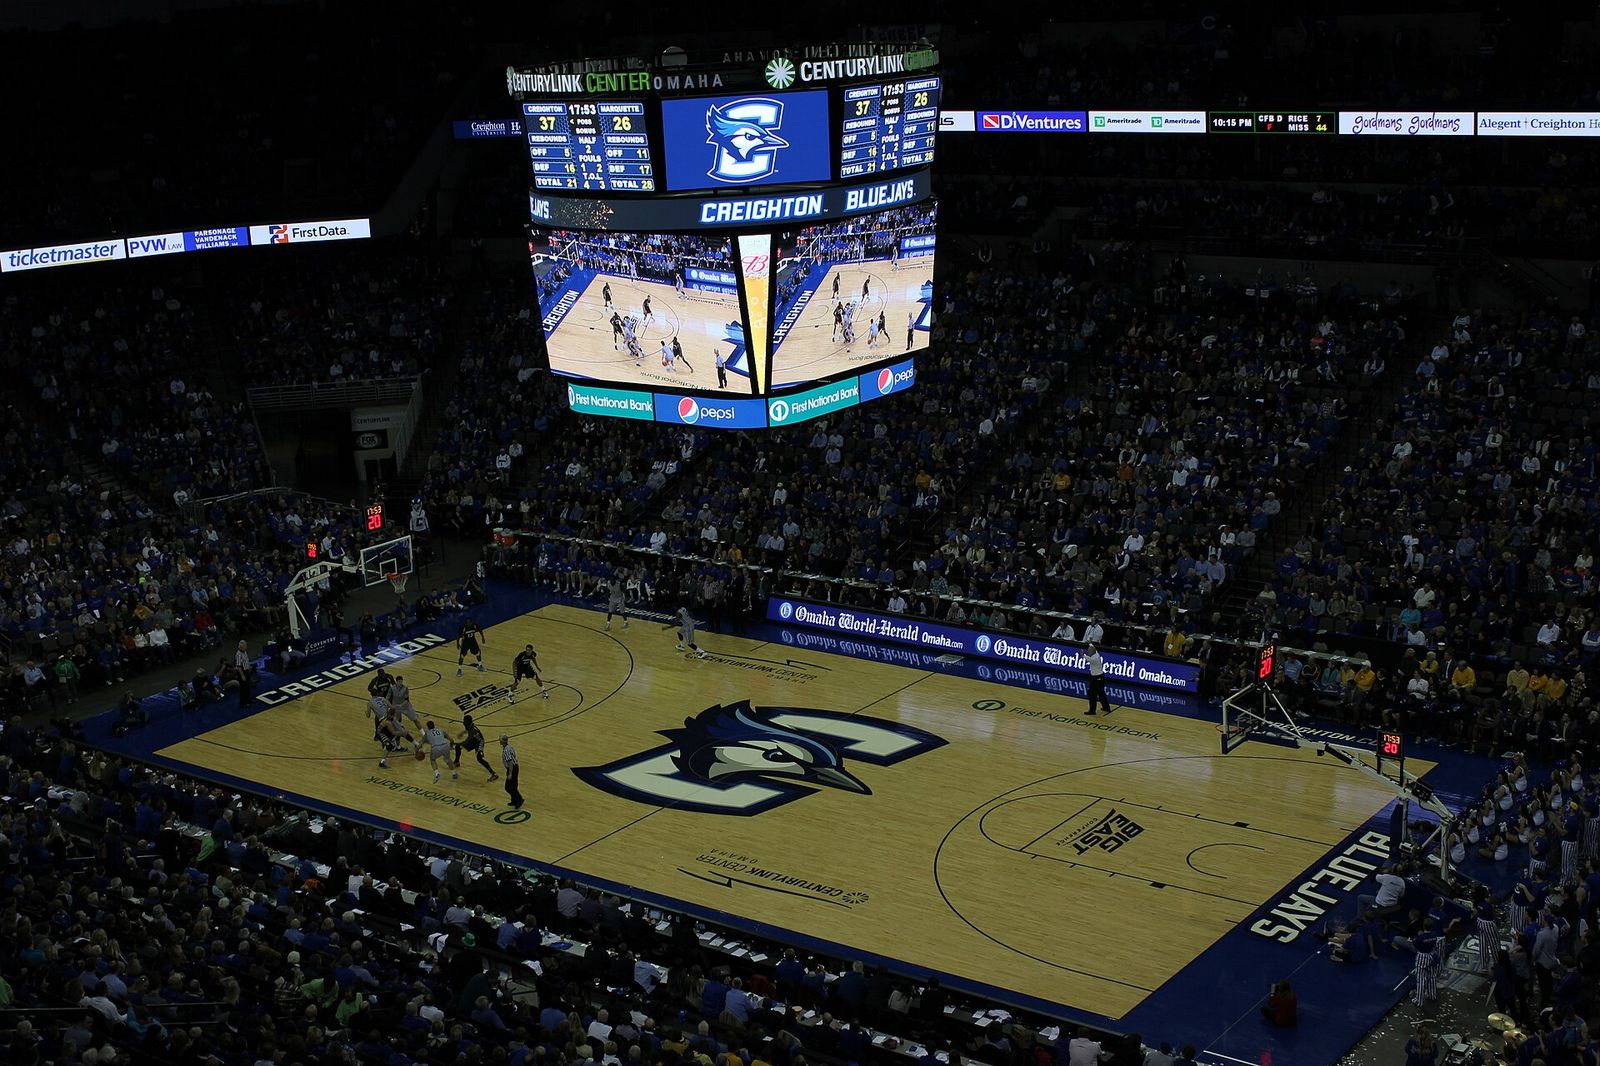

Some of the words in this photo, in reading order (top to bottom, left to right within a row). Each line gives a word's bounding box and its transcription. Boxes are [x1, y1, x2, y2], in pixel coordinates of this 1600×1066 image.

[800, 54, 905, 82] CENTURYLINK
[512, 72, 583, 93] CENTURYLINK
[586, 72, 650, 93] CENTER
[653, 74, 723, 90] OMAHA
[848, 88, 878, 98] CREIGHTON
[882, 84, 904, 96] 17:53
[907, 80, 936, 90] MARQUETTE
[569, 104, 596, 115] 17:53
[855, 100, 870, 116] 37
[914, 92, 928, 107] 26
[471, 121, 505, 132] Creighton
[539, 116, 556, 131] 37
[613, 116, 632, 131] 26
[846, 119, 876, 130] REBOUNDS
[884, 116, 899, 125] HALF
[906, 110, 935, 120] REBOUNDS
[1001, 111, 1082, 129] DiVentures
[1213, 118, 1237, 127] 10:15
[1239, 119, 1252, 127] PM
[1352, 112, 1402, 135] gordmans
[1408, 112, 1460, 135] gordmans
[1479, 118, 1521, 130] Alegent
[1530, 118, 1586, 130] Creighton
[843, 134, 857, 144] OFF
[870, 131, 876, 141] 5
[888, 125, 894, 134] 2
[904, 126, 917, 134] OFF
[927, 122, 934, 131] 11
[881, 134, 899, 143] FOULS
[564, 148, 570, 157] 5
[586, 145, 592, 154] 2
[637, 150, 648, 158] 11
[842, 151, 856, 160] DEF
[893, 142, 899, 152] 2
[903, 141, 916, 150] DEF
[926, 138, 934, 147] 17
[565, 164, 575, 173] 16
[581, 163, 586, 172] 1
[596, 164, 603, 173] 2
[609, 165, 625, 173] DEF
[639, 165, 650, 174] 17
[842, 165, 864, 175] TOTAL
[867, 162, 875, 172] 21
[880, 162, 886, 171] 4
[893, 159, 898, 168] 3
[902, 155, 923, 165] TOTAL
[925, 152, 933, 162] 28
[536, 179, 562, 187] TOTAL
[567, 179, 577, 187] 21
[584, 181, 590, 189] 4
[599, 181, 606, 189] 3
[642, 181, 653, 189] 28
[701, 196, 822, 223] CREIGHTON
[194, 228, 236, 237] PARSONAGE
[194, 234, 237, 243] VANDENACK
[292, 227, 318, 239] First
[319, 226, 346, 237] Data
[130, 238, 167, 255] PVW
[168, 243, 183, 251] LAW
[195, 241, 230, 250] WILLIAMS
[9, 243, 117, 268] ticketmaster
[542, 289, 580, 332] CREIGHTON
[773, 290, 813, 344] CREIGHTON
[894, 367, 915, 386] pepsi
[576, 392, 590, 405] First
[590, 394, 628, 409] National
[629, 399, 653, 412] Bank
[791, 399, 806, 415] First
[806, 388, 839, 412] National
[839, 382, 859, 403] Bank
[700, 406, 736, 421] pepsi
[367, 514, 381, 531] 20
[795, 605, 836, 627] Omaha
[838, 612, 919, 641] World-Herald
[921, 631, 964, 650] Omaha.com
[255, 632, 447, 705] CREIGHTON
[994, 639, 1040, 663] Omaha
[1043, 646, 1135, 678] World-erald
[1139, 667, 1186, 687] Omaha.com
[1259, 656, 1273, 680] 20
[775, 669, 818, 681] CENTER
[1009, 706, 1042, 719] First
[1043, 713, 1118, 733] National
[1116, 727, 1162, 742] Bank
[1383, 734, 1400, 744] 17:53
[1383, 742, 1399, 755] 20
[366, 775, 401, 791] Bank
[400, 784, 464, 809] National
[462, 803, 497, 815] First
[1072, 813, 1130, 856] EAST
[1099, 821, 1145, 853] BIG
[696, 853, 747, 872] CENTER
[711, 848, 759, 864] OMAHA
[748, 867, 844, 898] CENTURYLINK
[1249, 830, 1391, 945] BLUEJAYS
